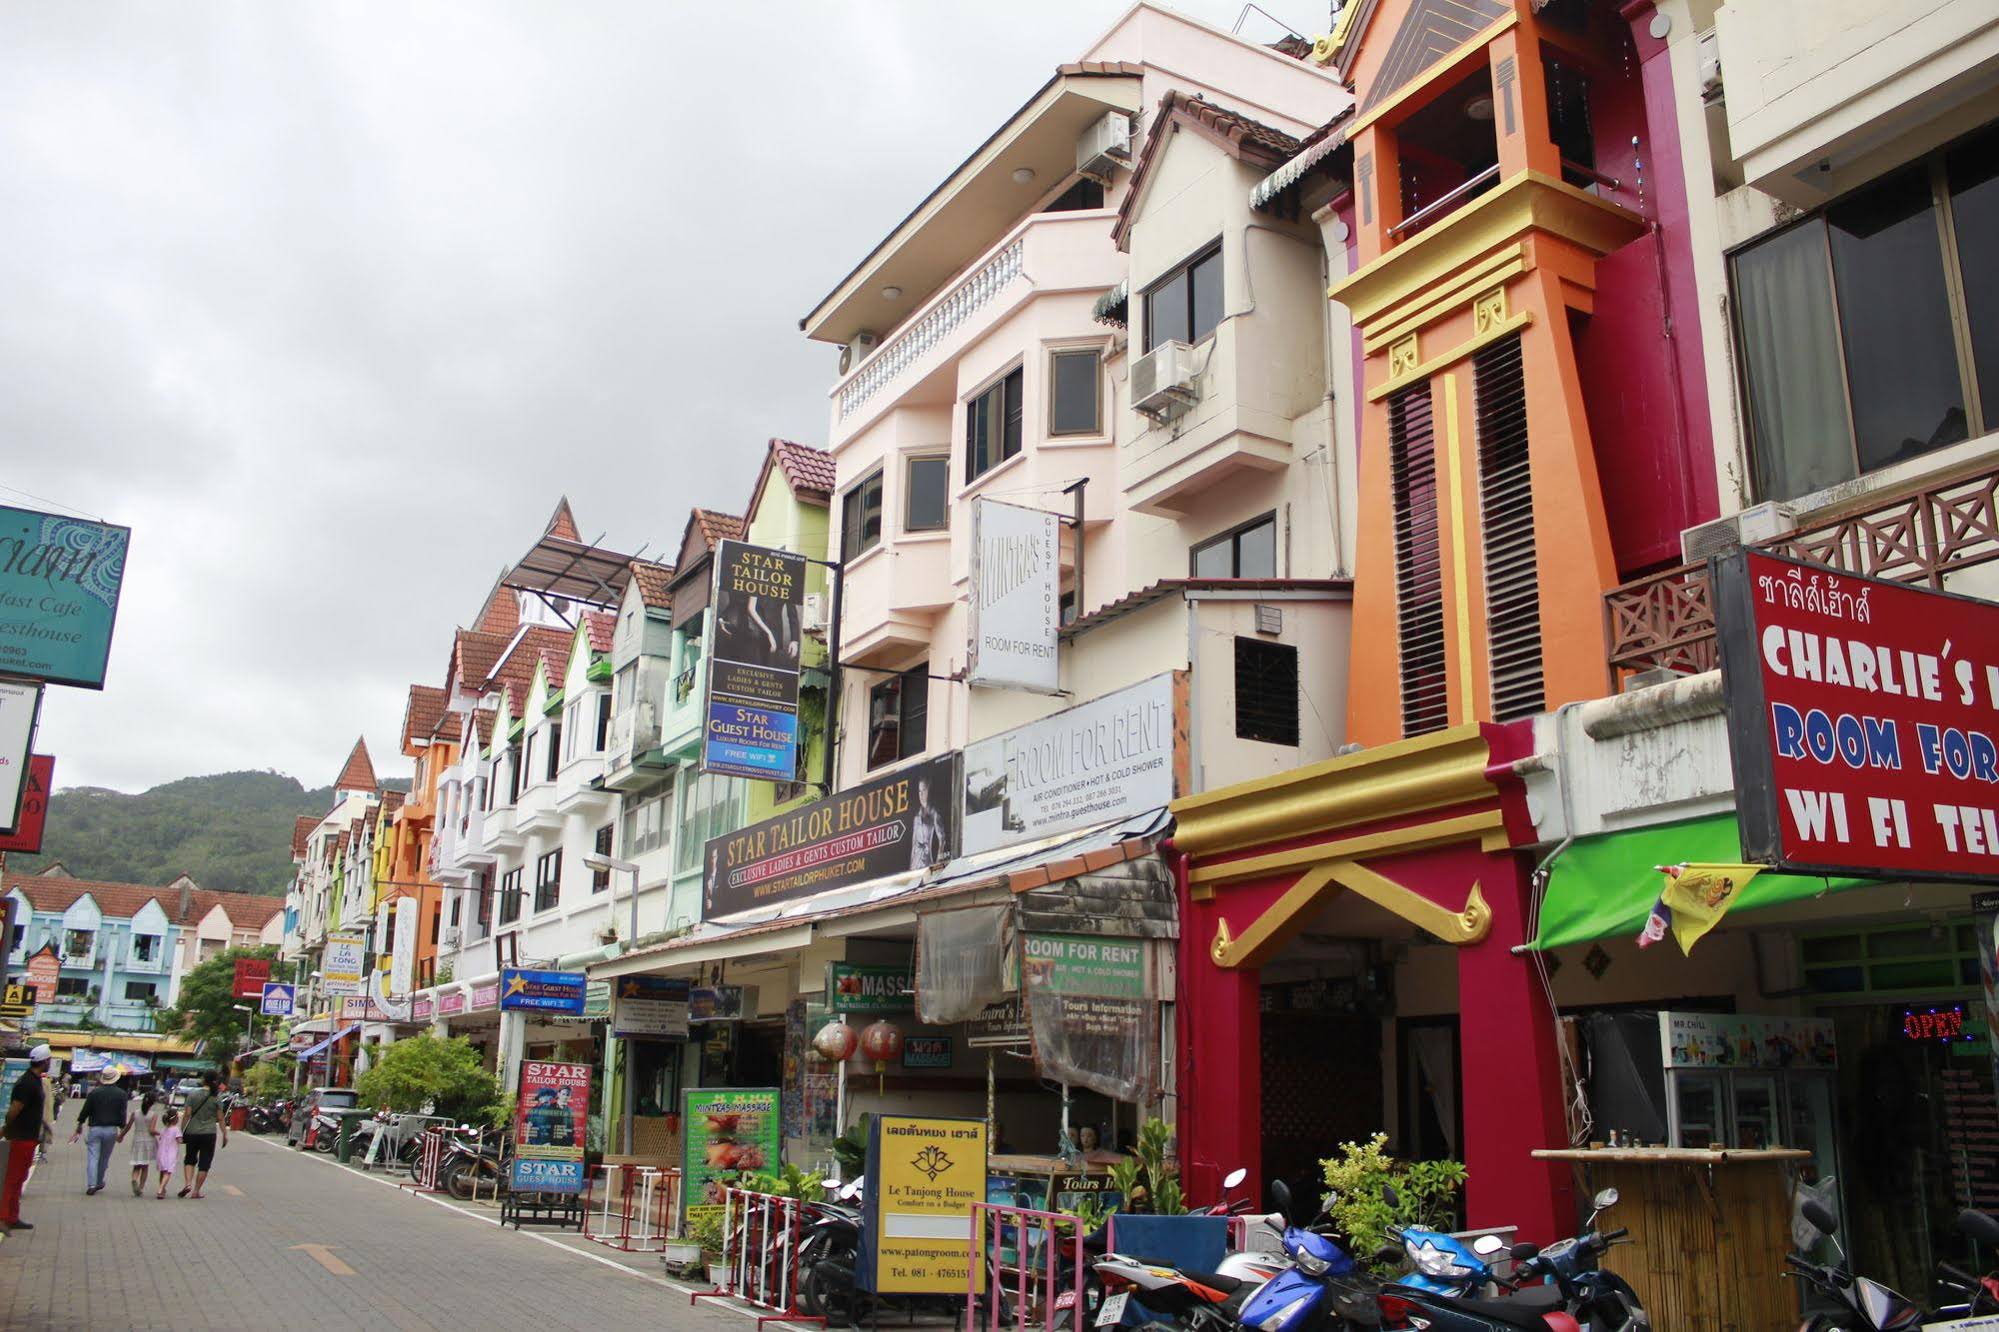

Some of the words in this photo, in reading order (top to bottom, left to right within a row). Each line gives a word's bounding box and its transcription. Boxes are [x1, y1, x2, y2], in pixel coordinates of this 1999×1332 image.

[742, 552, 785, 571] STAR
[732, 564, 793, 587] TAILOR
[733, 579, 790, 600] HOUSE
[985, 636, 1011, 652] ROOM
[1013, 640, 1031, 656] FOR
[1032, 643, 1055, 659] RENT
[737, 668, 775, 679] EXCLUSIVE
[1762, 625, 1975, 706] CHARLIE'S
[727, 675, 752, 685] LADIES
[762, 680, 784, 690] GENTS
[727, 683, 755, 694] CUSTOM
[758, 688, 782, 697] TAILOR
[736, 708, 769, 726] STAR
[710, 719, 750, 737] GUEST
[753, 725, 793, 744] HOUSE
[1015, 731, 1065, 791] ROOM
[1071, 719, 1108, 775] FOR
[1113, 699, 1165, 762] RENT
[1771, 701, 1903, 770] ROOM
[1916, 722, 1999, 785] FOR
[725, 749, 748, 760] FREE
[1032, 792, 1043, 802] AIR
[1043, 780, 1086, 800] CONDITIONER
[1090, 774, 1104, 786] HOT
[1105, 772, 1111, 782] &
[1112, 766, 1131, 779] COLD
[1132, 757, 1164, 775] SHOWER
[727, 830, 765, 868] STAR
[770, 807, 833, 853] TAILOR
[838, 780, 910, 833] HOUSE
[1784, 788, 1850, 844] WI
[1867, 796, 1911, 849] FI
[731, 863, 766, 886] EXCLUSIVE
[769, 858, 794, 875] LADIES
[796, 855, 802, 866] &
[804, 846, 828, 863] GENTS
[830, 838, 864, 858] CUSTOM
[866, 825, 899, 847] TAILOR
[753, 858, 866, 898] WWW.STARTAILORPHUKET.COM
[1024, 939, 1064, 958] ROOM
[1068, 943, 1097, 960] FOR
[1102, 946, 1139, 963] RENT
[521, 998, 540, 1006] FREE
[1063, 1000, 1088, 1012] Tours
[1092, 1002, 1142, 1016] Information
[1904, 1011, 1962, 1040] OPEN
[528, 1063, 587, 1079] STAR
[526, 1076, 557, 1085] TAILOR
[559, 1078, 587, 1087] HOUSE
[520, 1162, 577, 1176] STAR
[516, 1175, 546, 1184] GUEST
[549, 1176, 578, 1184] HOUSE
[1062, 1176, 1100, 1190] Tours
[888, 1185, 901, 1196] Le
[904, 1185, 942, 1199] Tanjong
[945, 1187, 975, 1198] House
[897, 1199, 924, 1207] Comfort
[943, 1200, 966, 1209] Budget
[891, 1267, 908, 1278] Tel.
